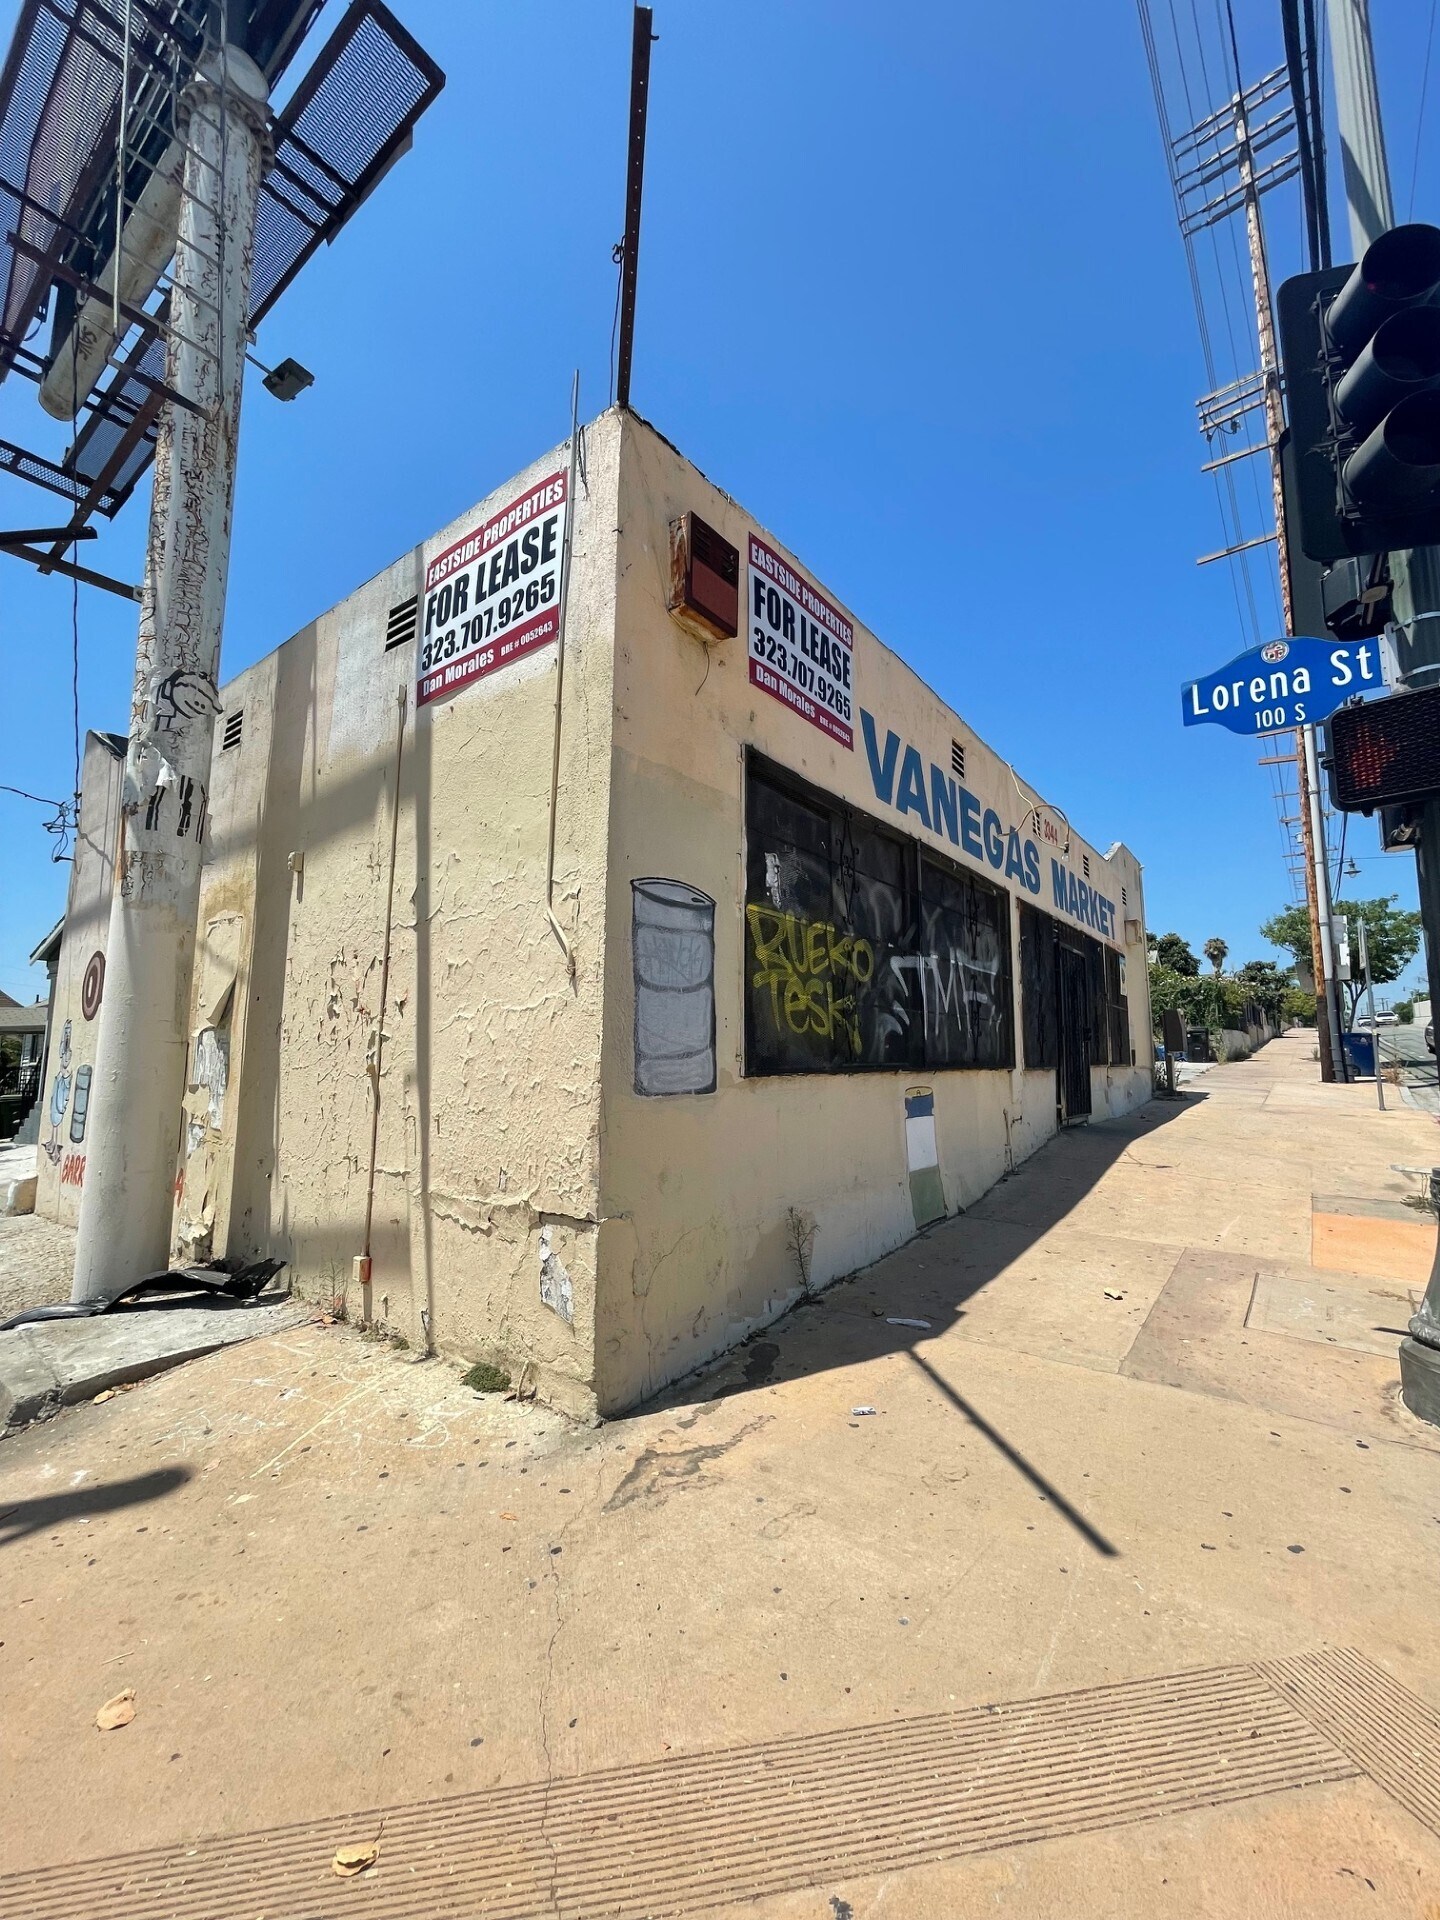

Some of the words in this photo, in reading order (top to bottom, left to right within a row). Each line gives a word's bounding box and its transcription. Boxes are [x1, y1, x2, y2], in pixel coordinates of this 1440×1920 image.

[424, 573, 470, 637] FOR
[475, 514, 559, 604] LEASE
[428, 535, 481, 587] EASTSIDE
[482, 478, 564, 550] PROPERTIES
[421, 569, 555, 671] 323.707.9265
[752, 542, 801, 598] EASTSIDE
[802, 586, 853, 644] PROPERTIES
[753, 575, 796, 645] FOR
[800, 613, 851, 691] LEASE
[423, 673, 443, 697] Dan
[445, 648, 495, 686] Morales
[753, 626, 852, 722] 323.707.9265
[755, 665, 777, 690] Dan
[778, 677, 816, 718] Morales
[1191, 667, 1311, 716] Lorena
[1330, 645, 1374, 686] St
[1254, 706, 1286, 729] 100
[1294, 703, 1306, 722] S
[859, 706, 1041, 895] VANEGAS
[1050, 857, 1116, 940] MARKET
